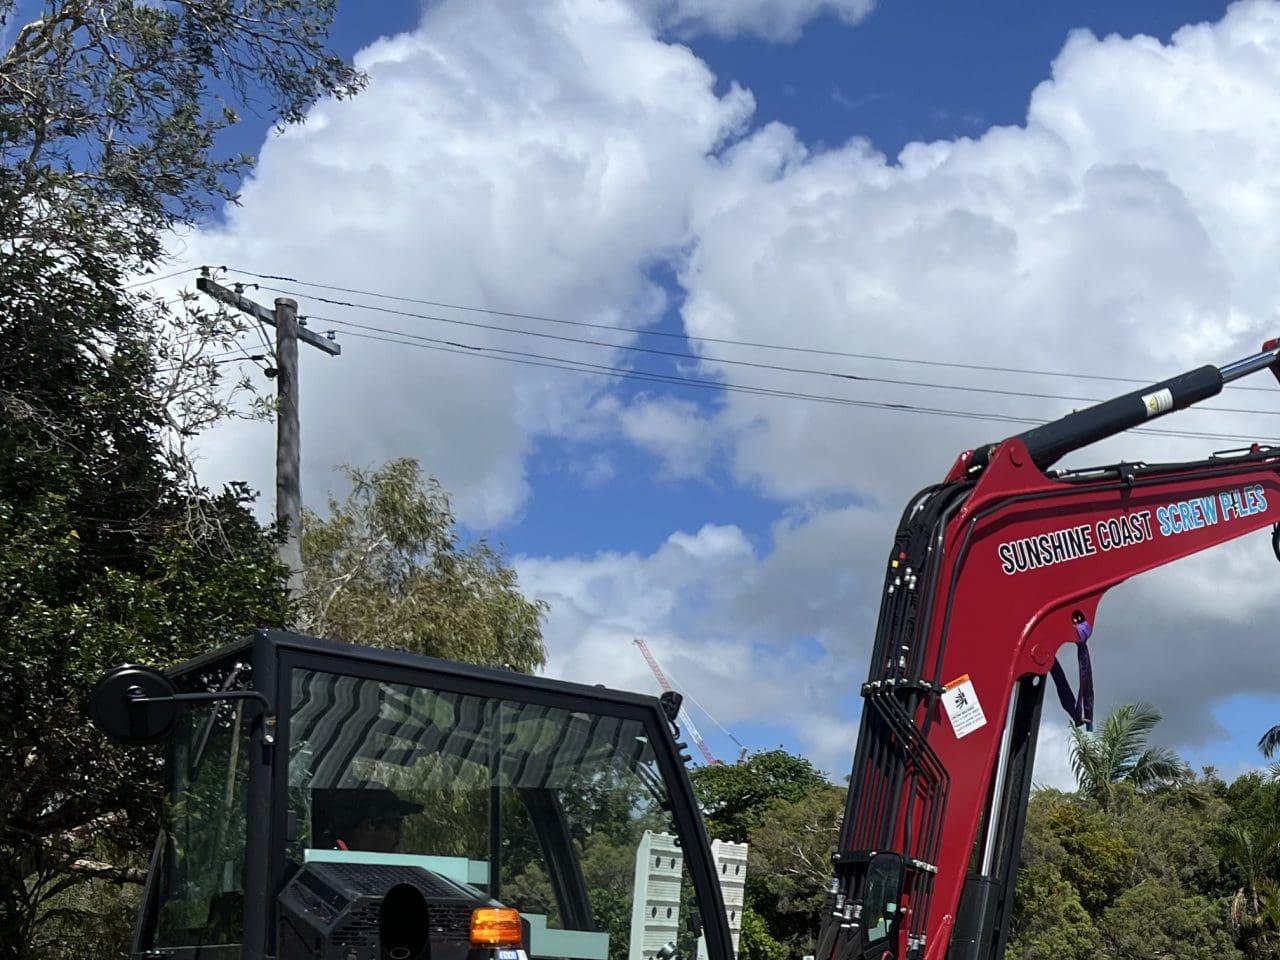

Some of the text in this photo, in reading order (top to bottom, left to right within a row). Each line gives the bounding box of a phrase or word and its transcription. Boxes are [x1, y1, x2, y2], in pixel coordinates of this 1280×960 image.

[998, 524, 1097, 575] SUNSHINE
[1095, 511, 1154, 551] COAST
[1156, 496, 1219, 537] SCREW
